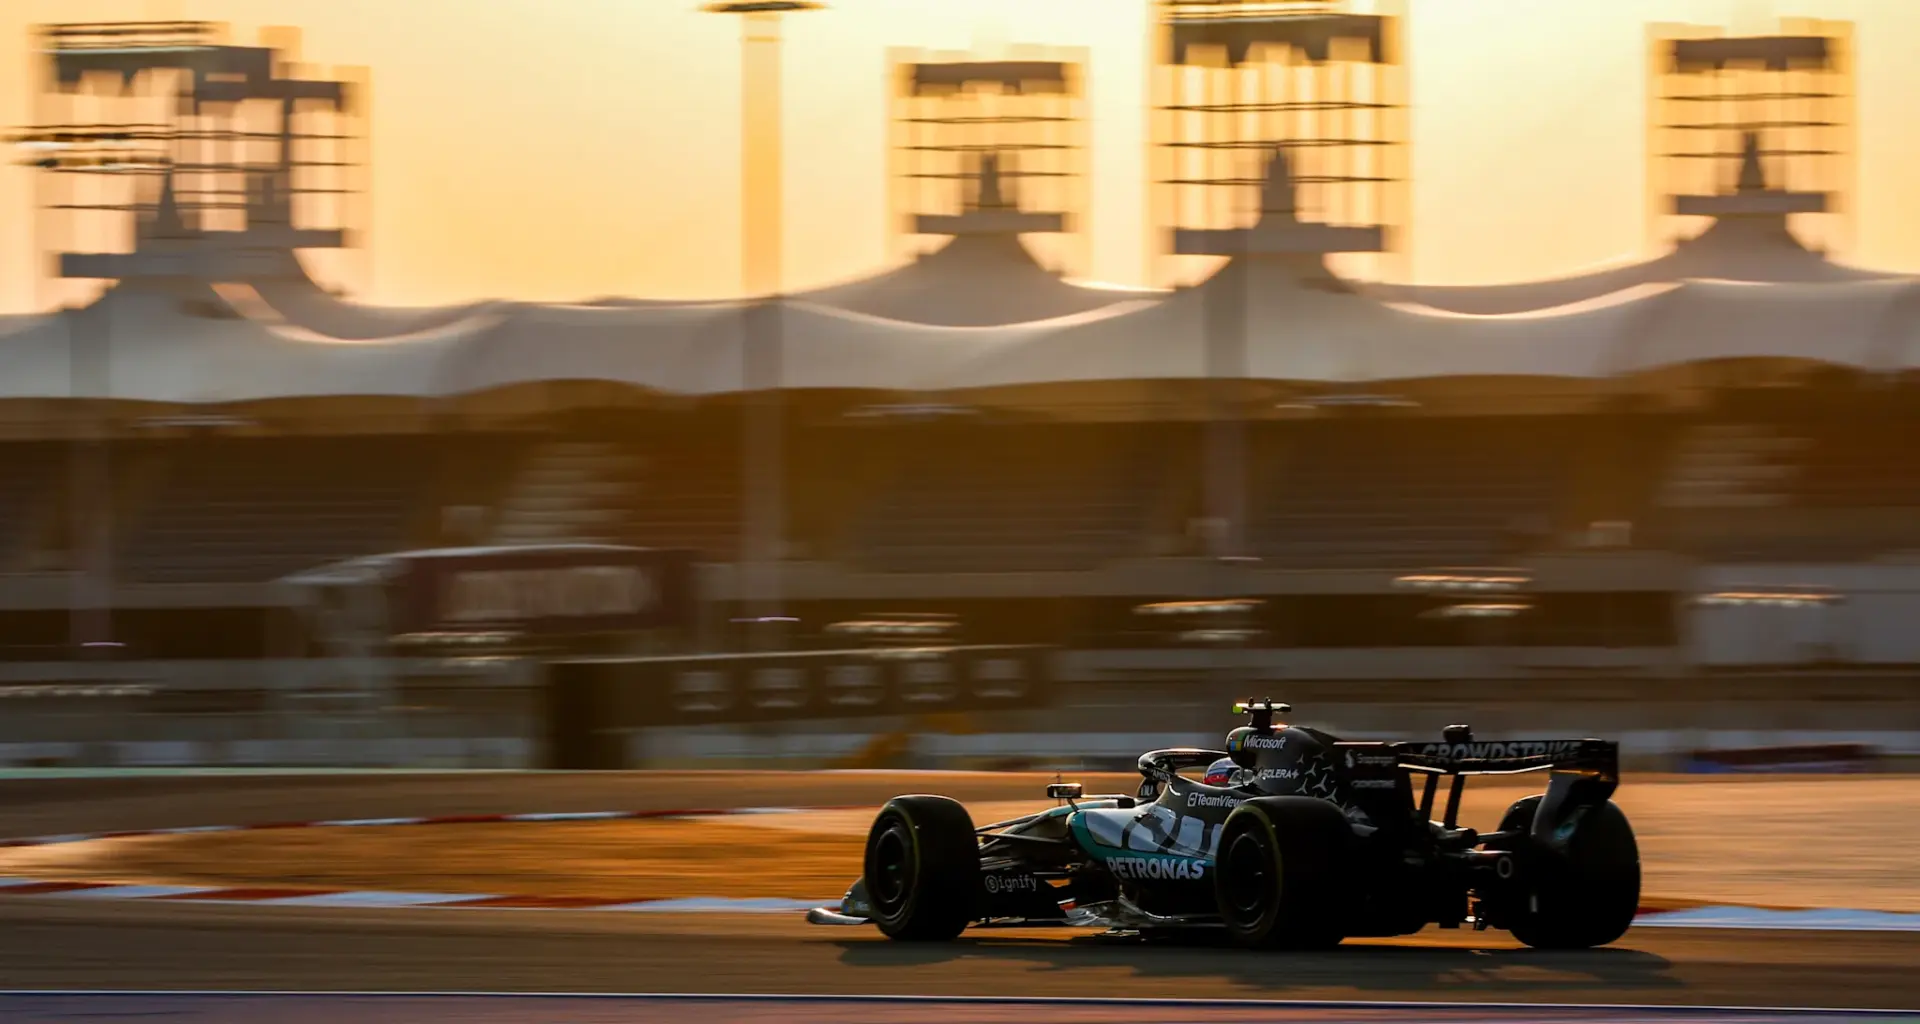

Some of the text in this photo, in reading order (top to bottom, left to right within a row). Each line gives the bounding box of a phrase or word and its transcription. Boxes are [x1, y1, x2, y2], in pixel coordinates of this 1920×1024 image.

[1243, 734, 1287, 749] Microsoft
[1422, 742, 1582, 763] CROWDSTRIKE
[1106, 856, 1207, 880] PETRONAS
